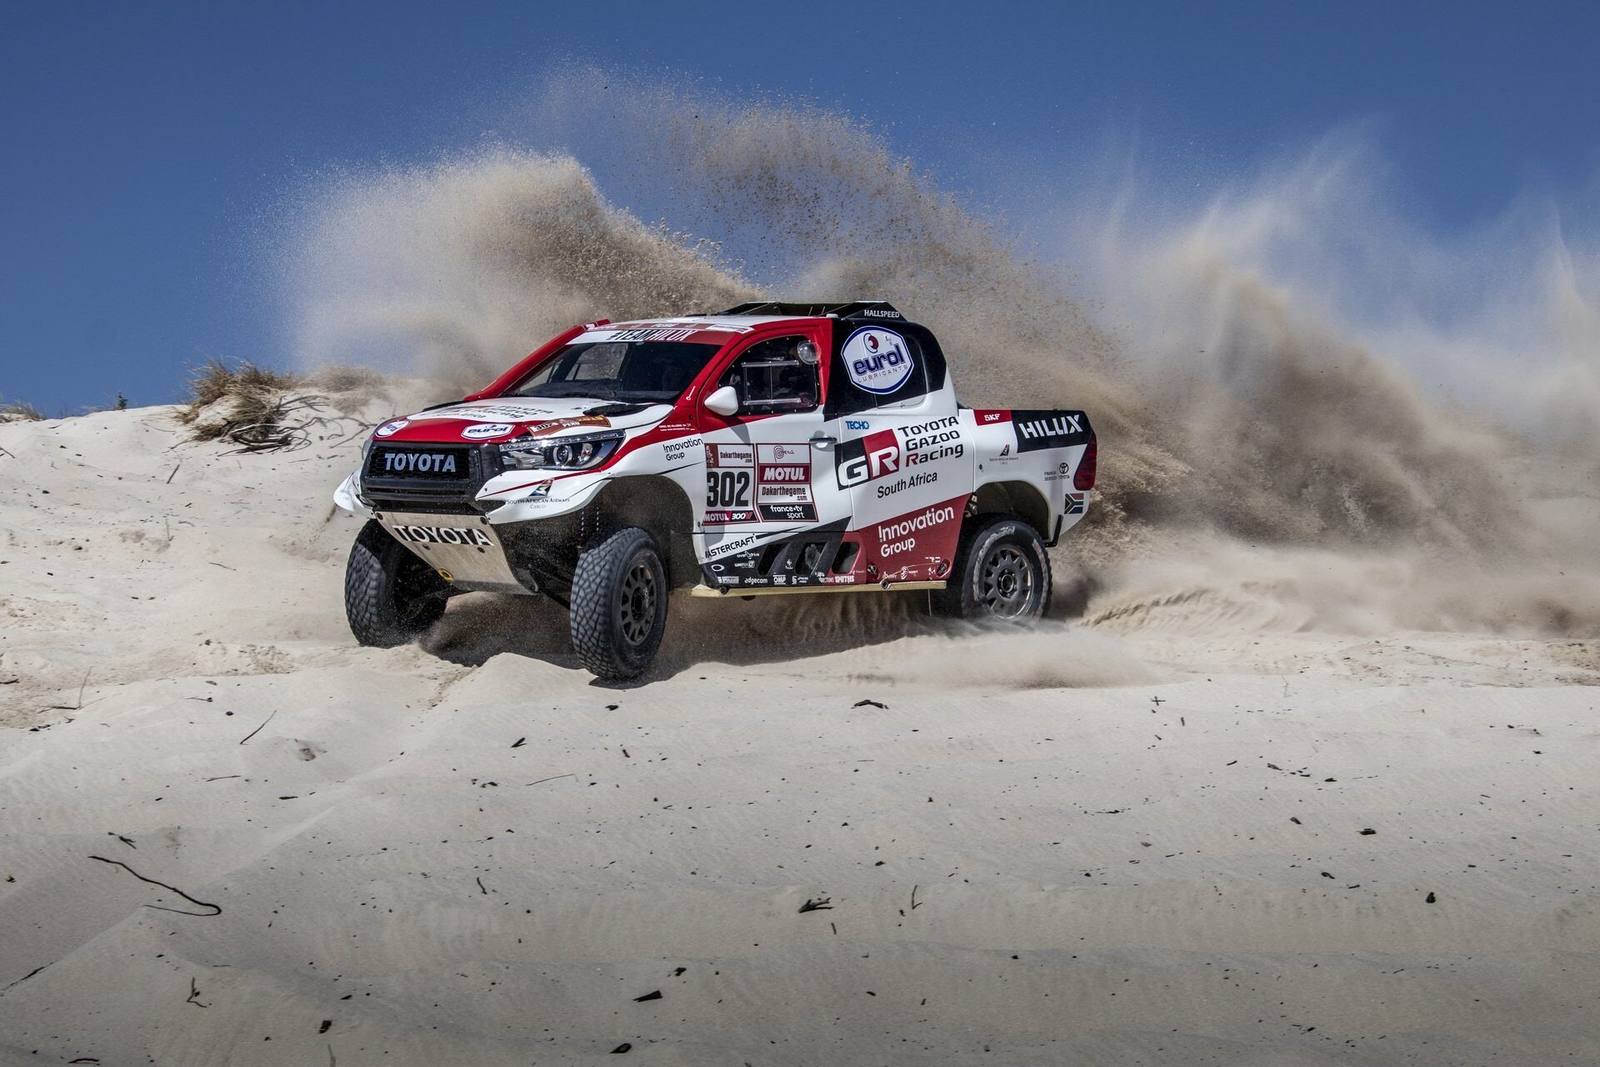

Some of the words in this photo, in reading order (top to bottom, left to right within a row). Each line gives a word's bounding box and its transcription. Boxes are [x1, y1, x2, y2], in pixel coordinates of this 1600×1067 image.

[864, 309, 900, 318] HALLSPEED
[853, 343, 905, 376] eurol
[845, 420, 870, 430] TECHO
[898, 416, 959, 437] TOYOTA
[984, 413, 1000, 421] SKF
[1019, 414, 1083, 438] HILUX
[468, 426, 508, 434] eurol
[663, 438, 703, 453] Innovation
[906, 430, 960, 451] GAZOO
[384, 453, 456, 473] TOYOTA
[665, 452, 685, 461] Group
[906, 443, 964, 467] Racing
[763, 467, 805, 480] MOTUL
[837, 445, 898, 487] GR
[707, 471, 750, 507] 302
[761, 486, 806, 496] Dakarthegame
[877, 480, 907, 499] South
[908, 472, 938, 489] Africa
[704, 512, 730, 521] MOTUL
[786, 512, 805, 520] sport
[878, 506, 954, 543] Innovation
[391, 525, 495, 547] TOYOTA
[880, 537, 916, 558] Group
